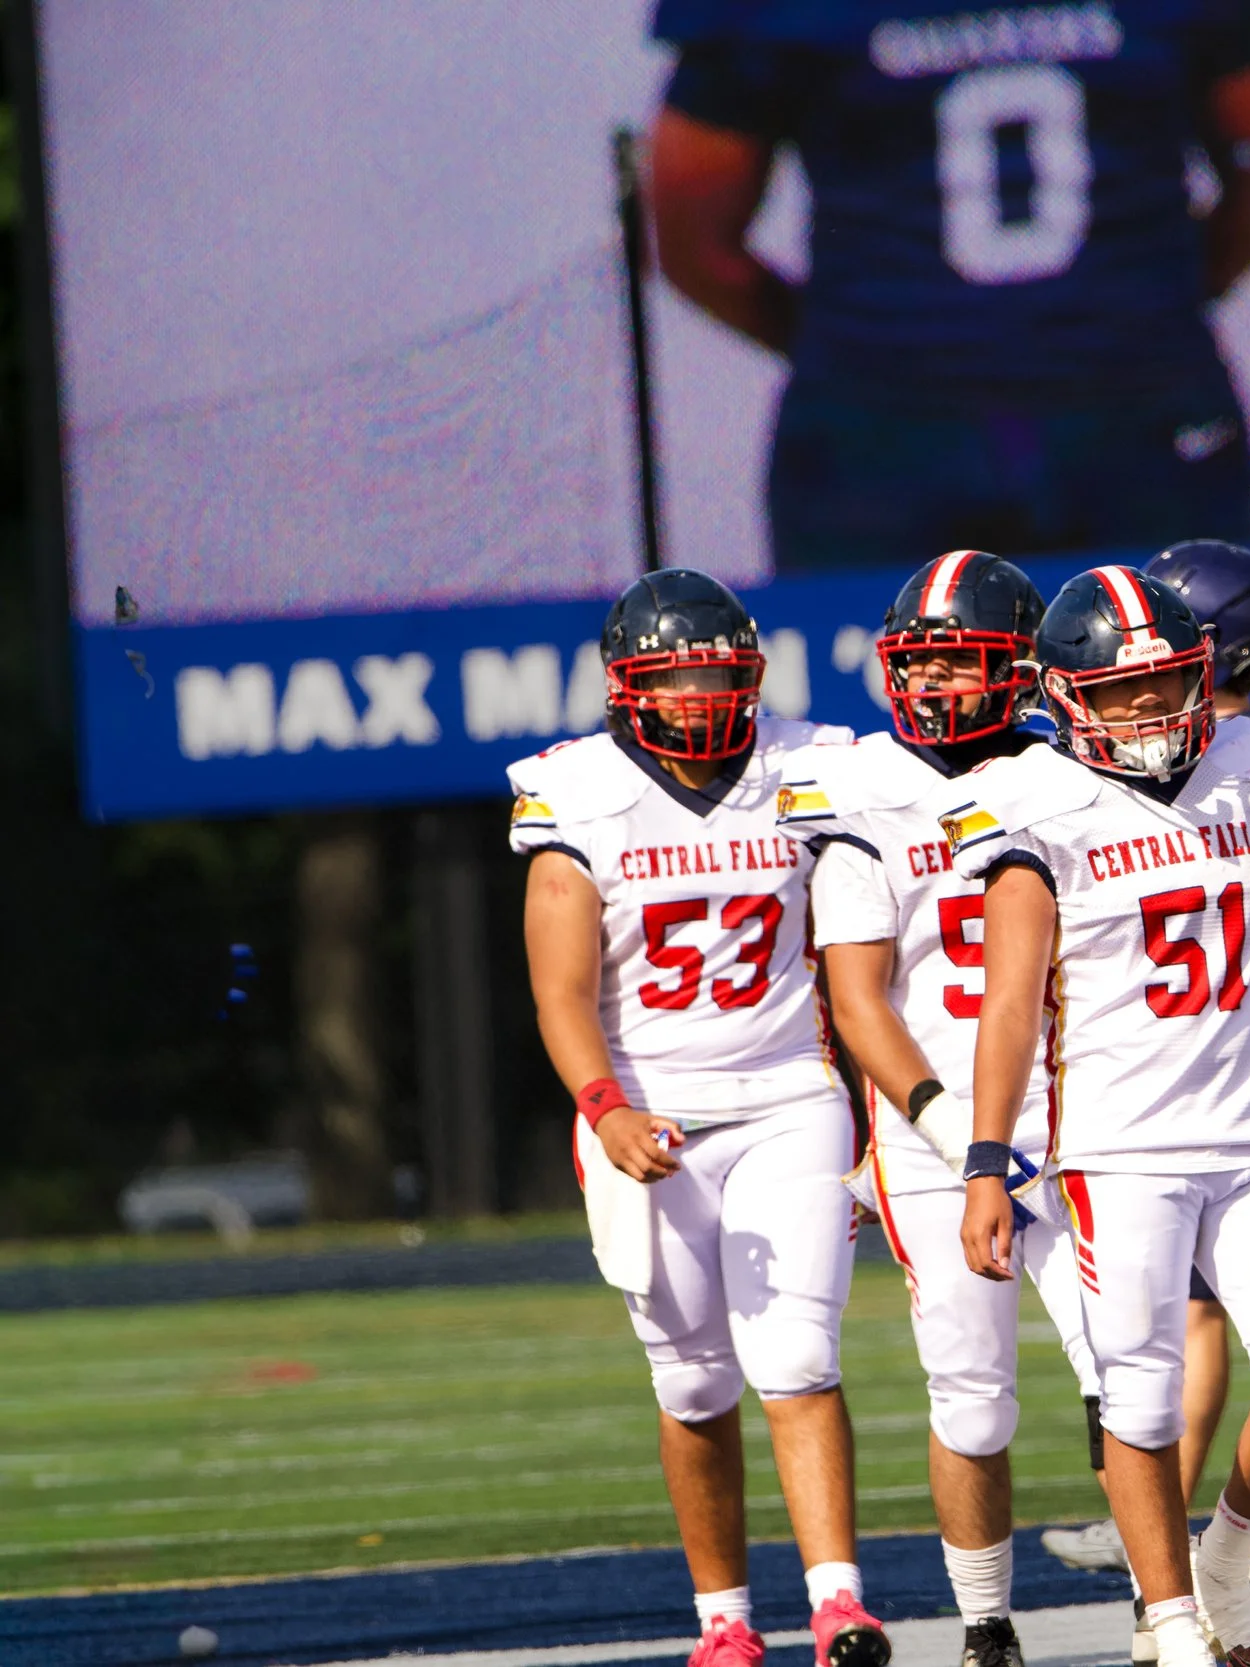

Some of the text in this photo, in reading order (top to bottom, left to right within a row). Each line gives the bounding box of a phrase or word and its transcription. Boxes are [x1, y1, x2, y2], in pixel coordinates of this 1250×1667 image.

[937, 63, 1092, 285] 0
[175, 651, 441, 761] MAX
[620, 837, 799, 881] CENTRAL FALLS
[1087, 829, 1196, 882] CENTRAL
[638, 893, 785, 1011] 53
[1139, 881, 1247, 1019] 51
